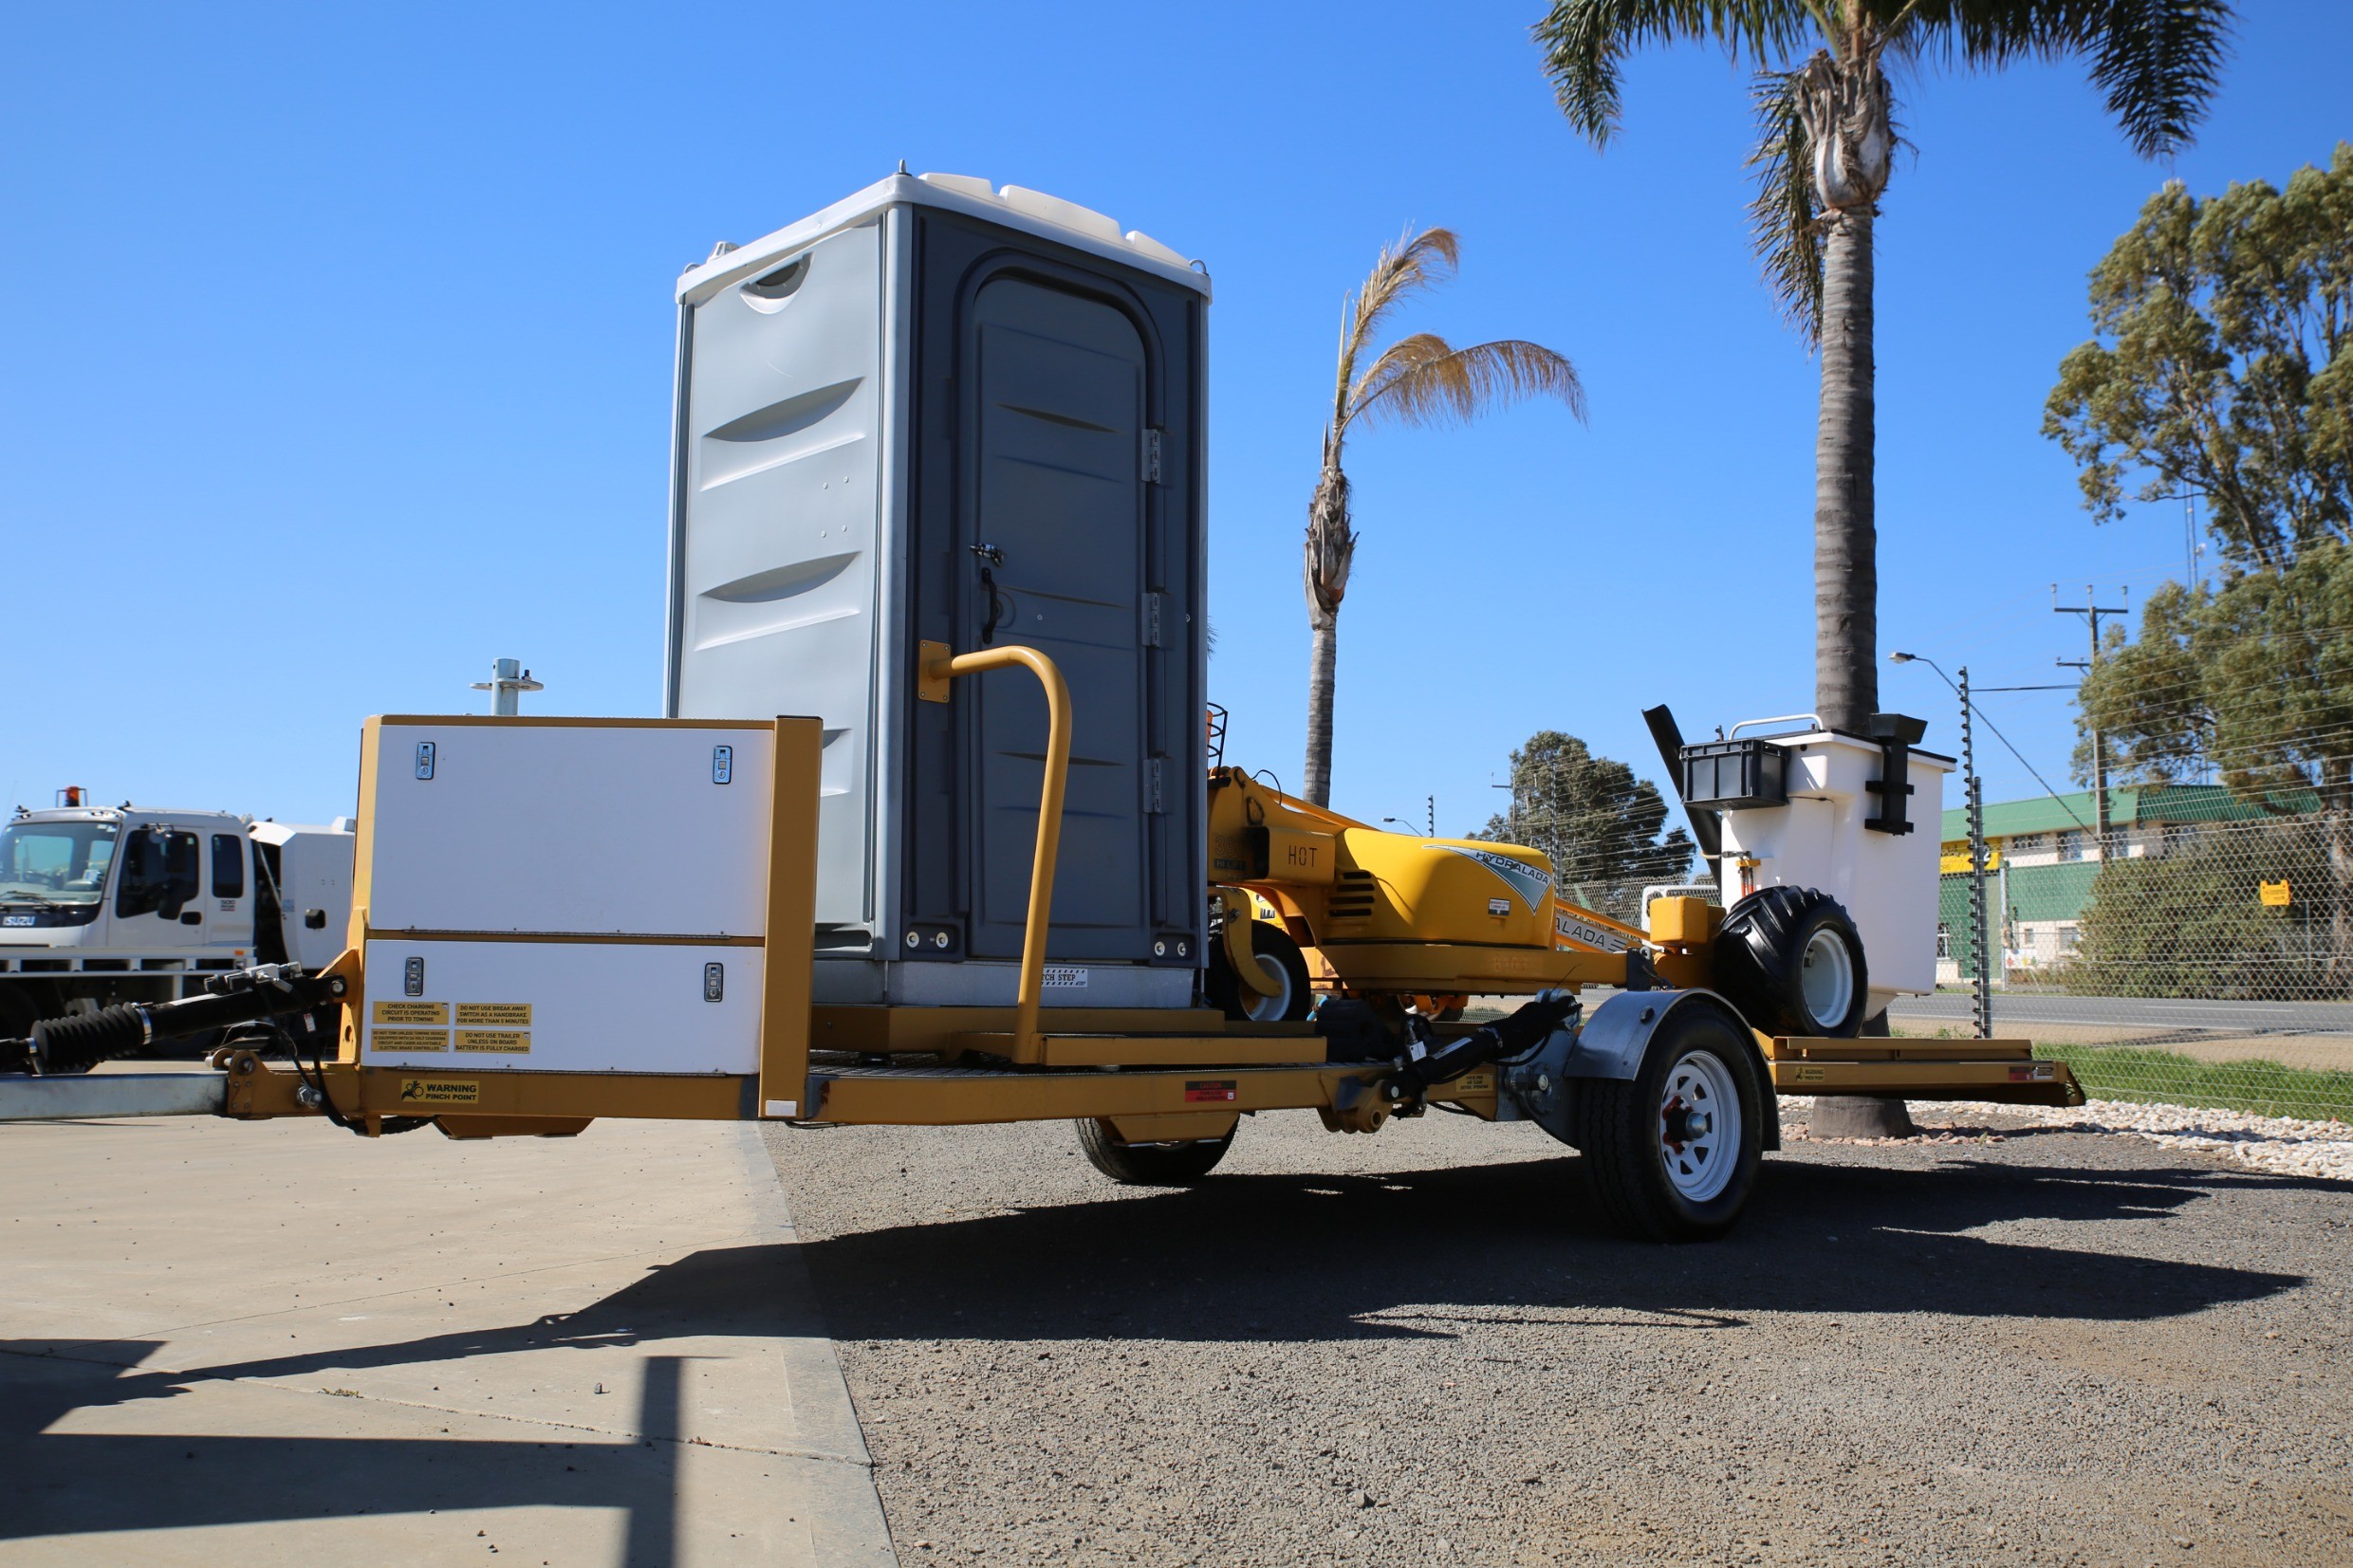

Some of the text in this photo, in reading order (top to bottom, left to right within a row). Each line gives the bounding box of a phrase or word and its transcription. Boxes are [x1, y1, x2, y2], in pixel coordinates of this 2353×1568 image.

[1288, 845, 1317, 867] HOT
[1475, 851, 1549, 885] HYDRALADA
[3, 916, 36, 926] ISUZU
[427, 1084, 476, 1093] WARNING
